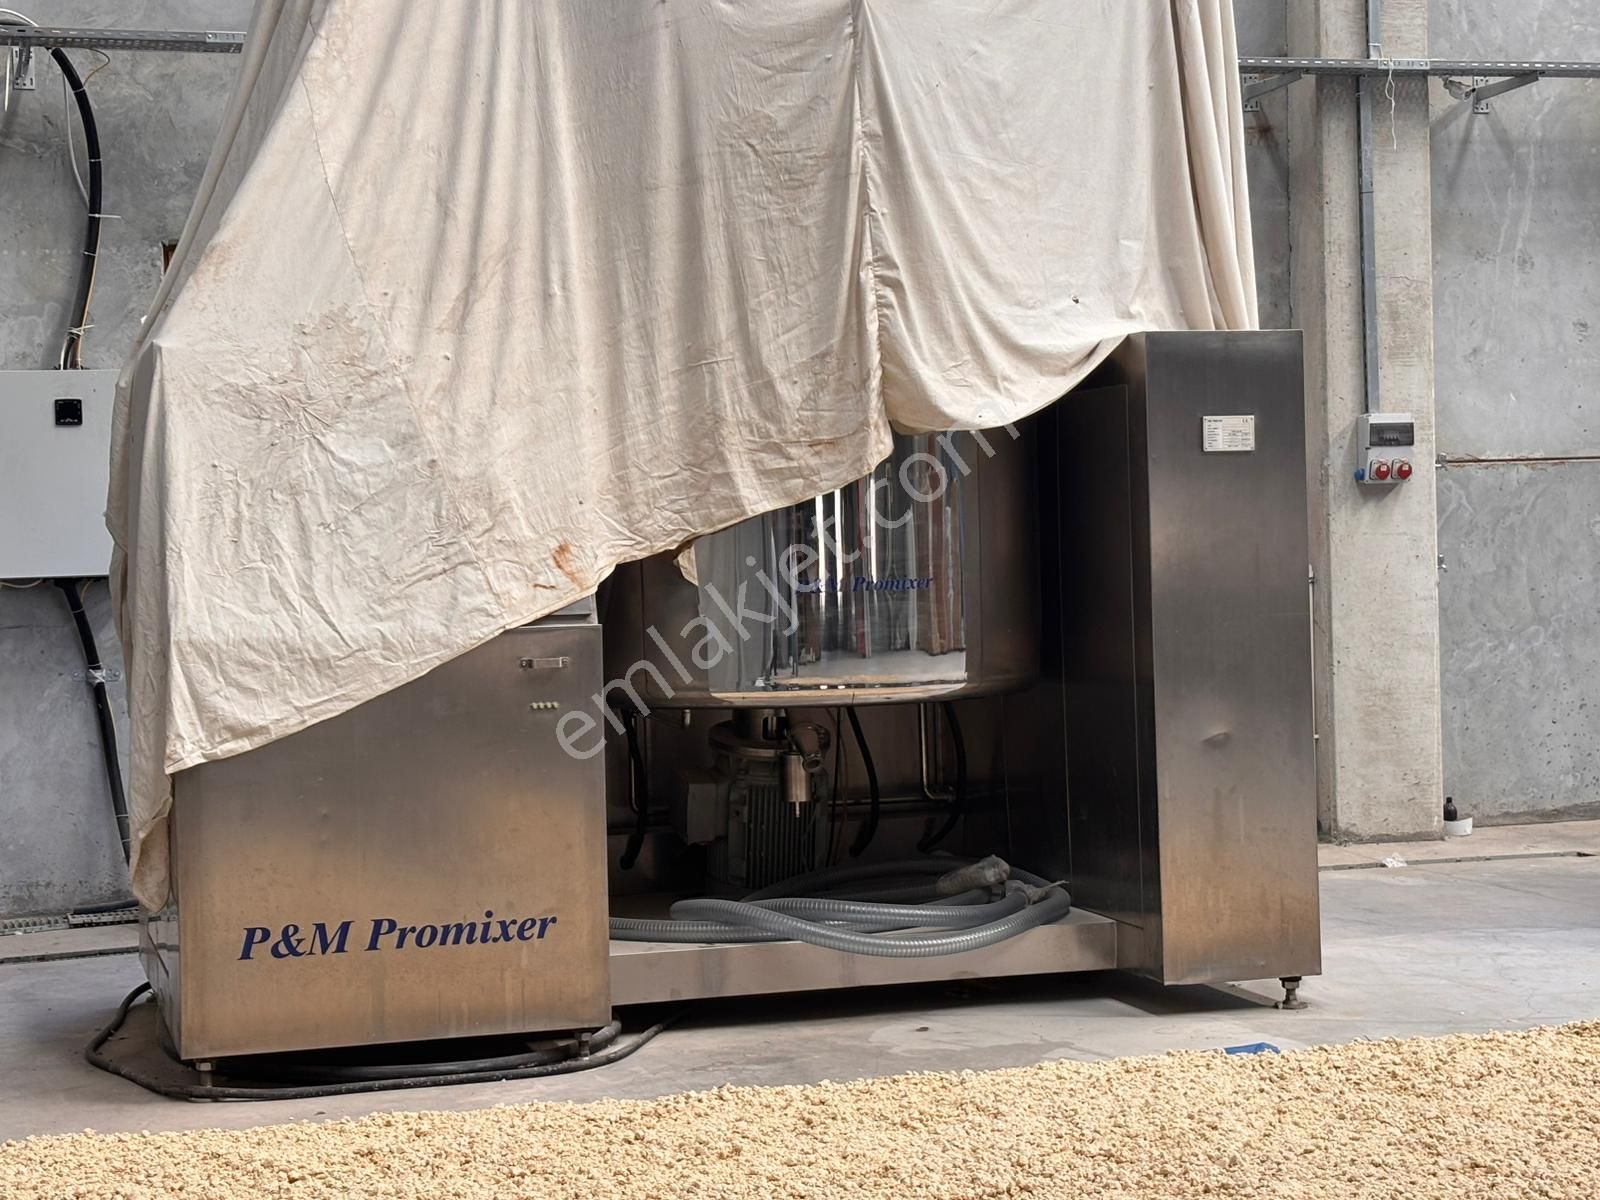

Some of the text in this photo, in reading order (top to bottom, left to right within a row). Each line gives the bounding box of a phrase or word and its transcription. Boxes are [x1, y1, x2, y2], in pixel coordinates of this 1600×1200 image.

[852, 575, 933, 592] Promixer
[237, 910, 558, 961] P&M Promixer
